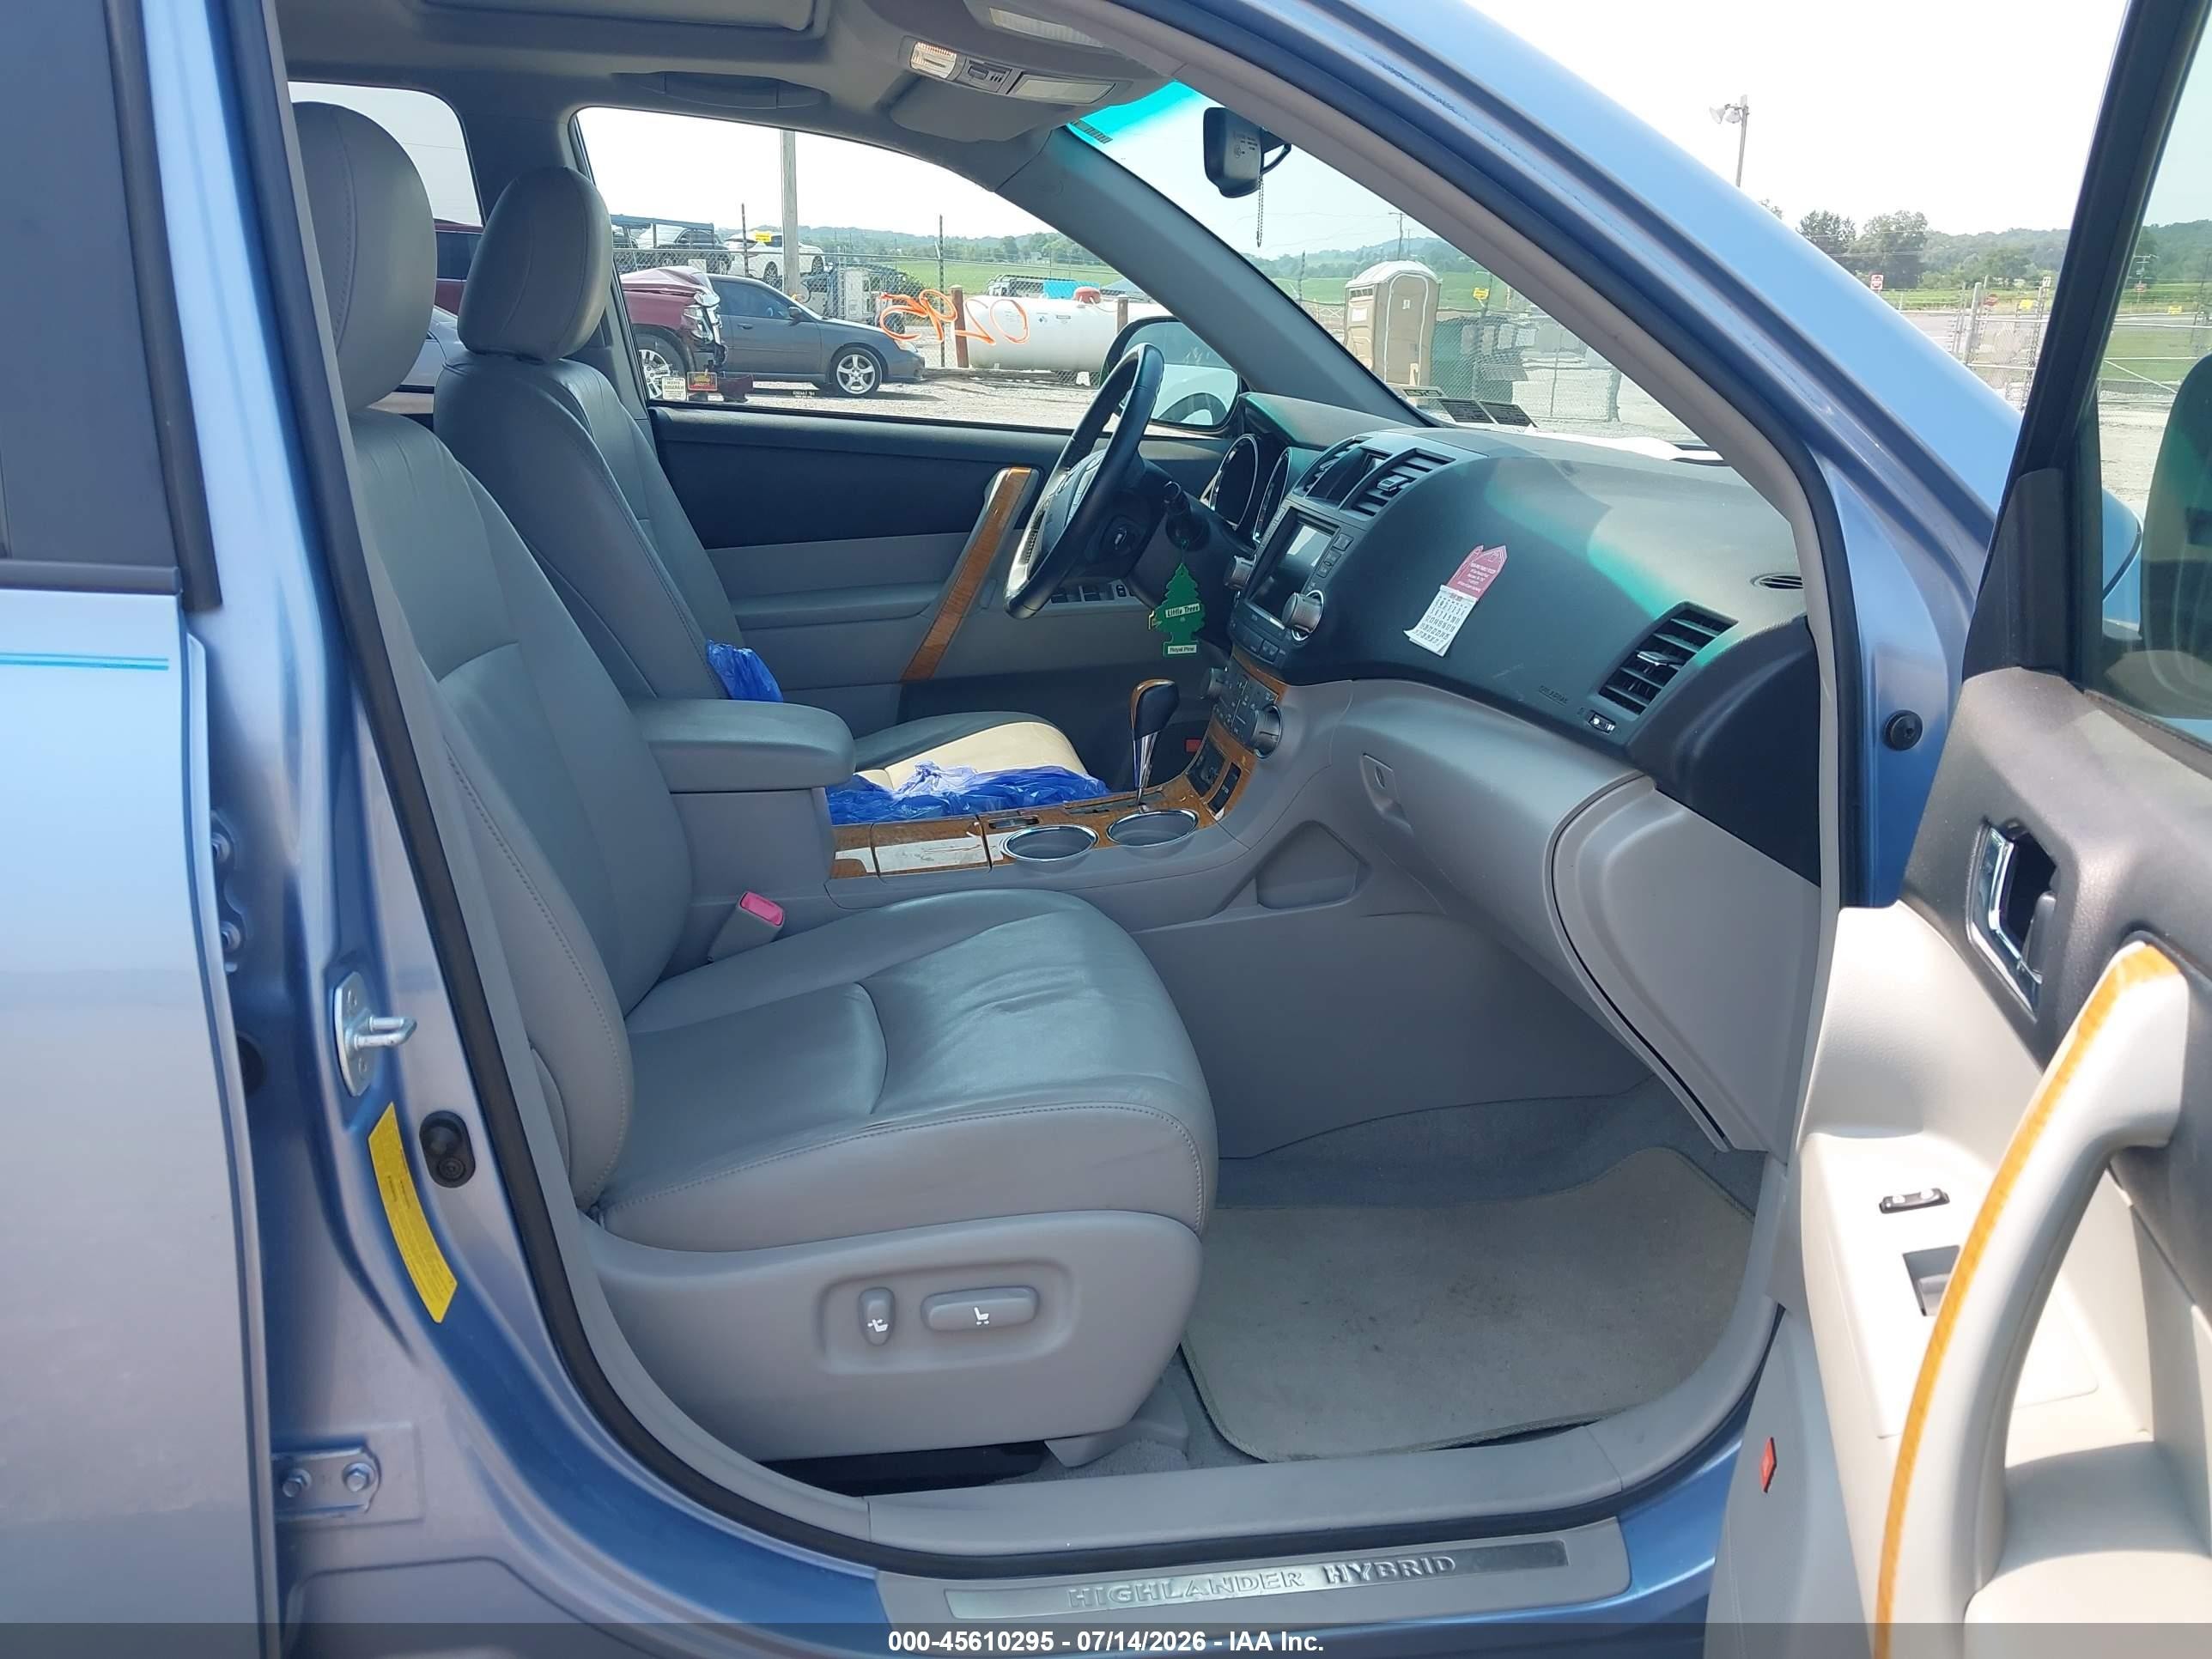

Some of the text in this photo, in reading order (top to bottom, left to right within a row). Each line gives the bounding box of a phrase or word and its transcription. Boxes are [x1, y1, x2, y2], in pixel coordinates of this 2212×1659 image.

[1168, 605, 1199, 617] Little Trees
[1068, 1556, 1457, 1608] HIGHLANDER HYBRID
